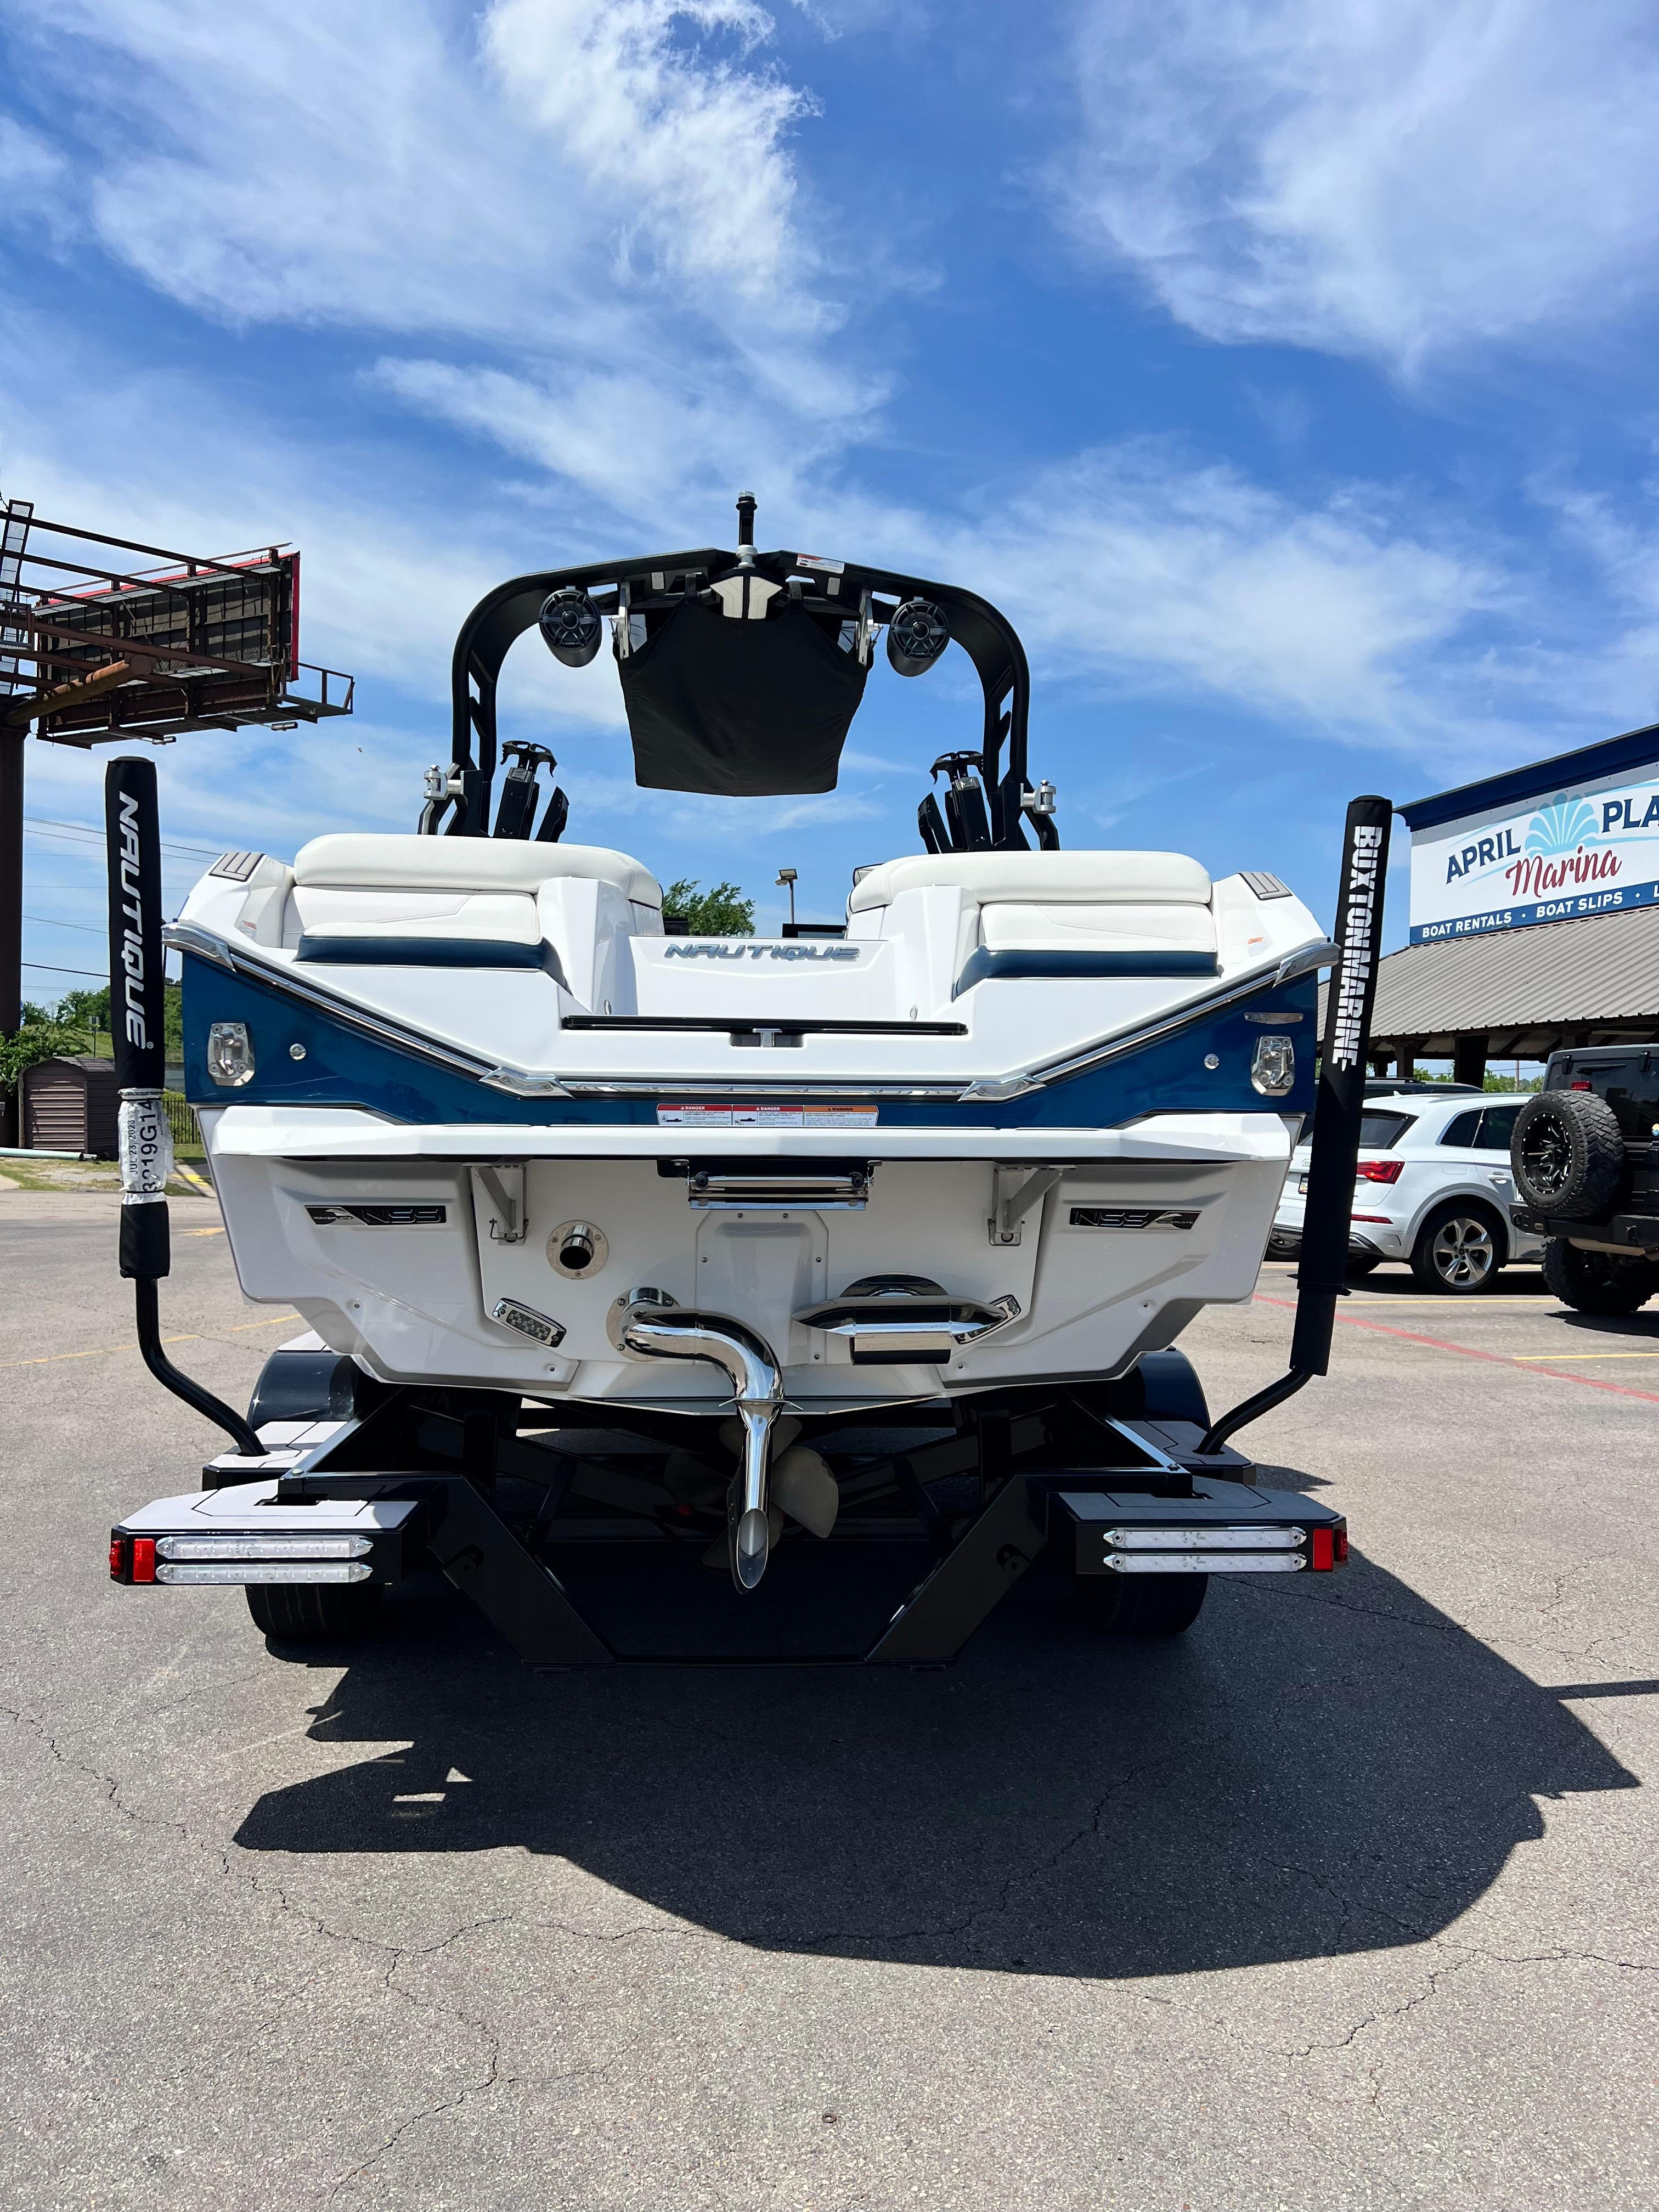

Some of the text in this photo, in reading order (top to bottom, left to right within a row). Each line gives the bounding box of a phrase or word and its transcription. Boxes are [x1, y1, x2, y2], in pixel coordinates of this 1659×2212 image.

[1446, 795, 1659, 885] APRIL PLA
[1505, 845, 1622, 898] Marina
[119, 791, 145, 1049] NAUTIQUE
[1422, 923, 1452, 939] BOAT
[1456, 912, 1513, 933] RENTALS
[1536, 900, 1573, 918] BOAT
[1578, 891, 1623, 911] SLIPS
[664, 944, 860, 961] NAUTIQUE
[127, 1120, 136, 1140] 2023
[129, 1142, 137, 1155] 23,
[129, 1158, 138, 1175] JUL
